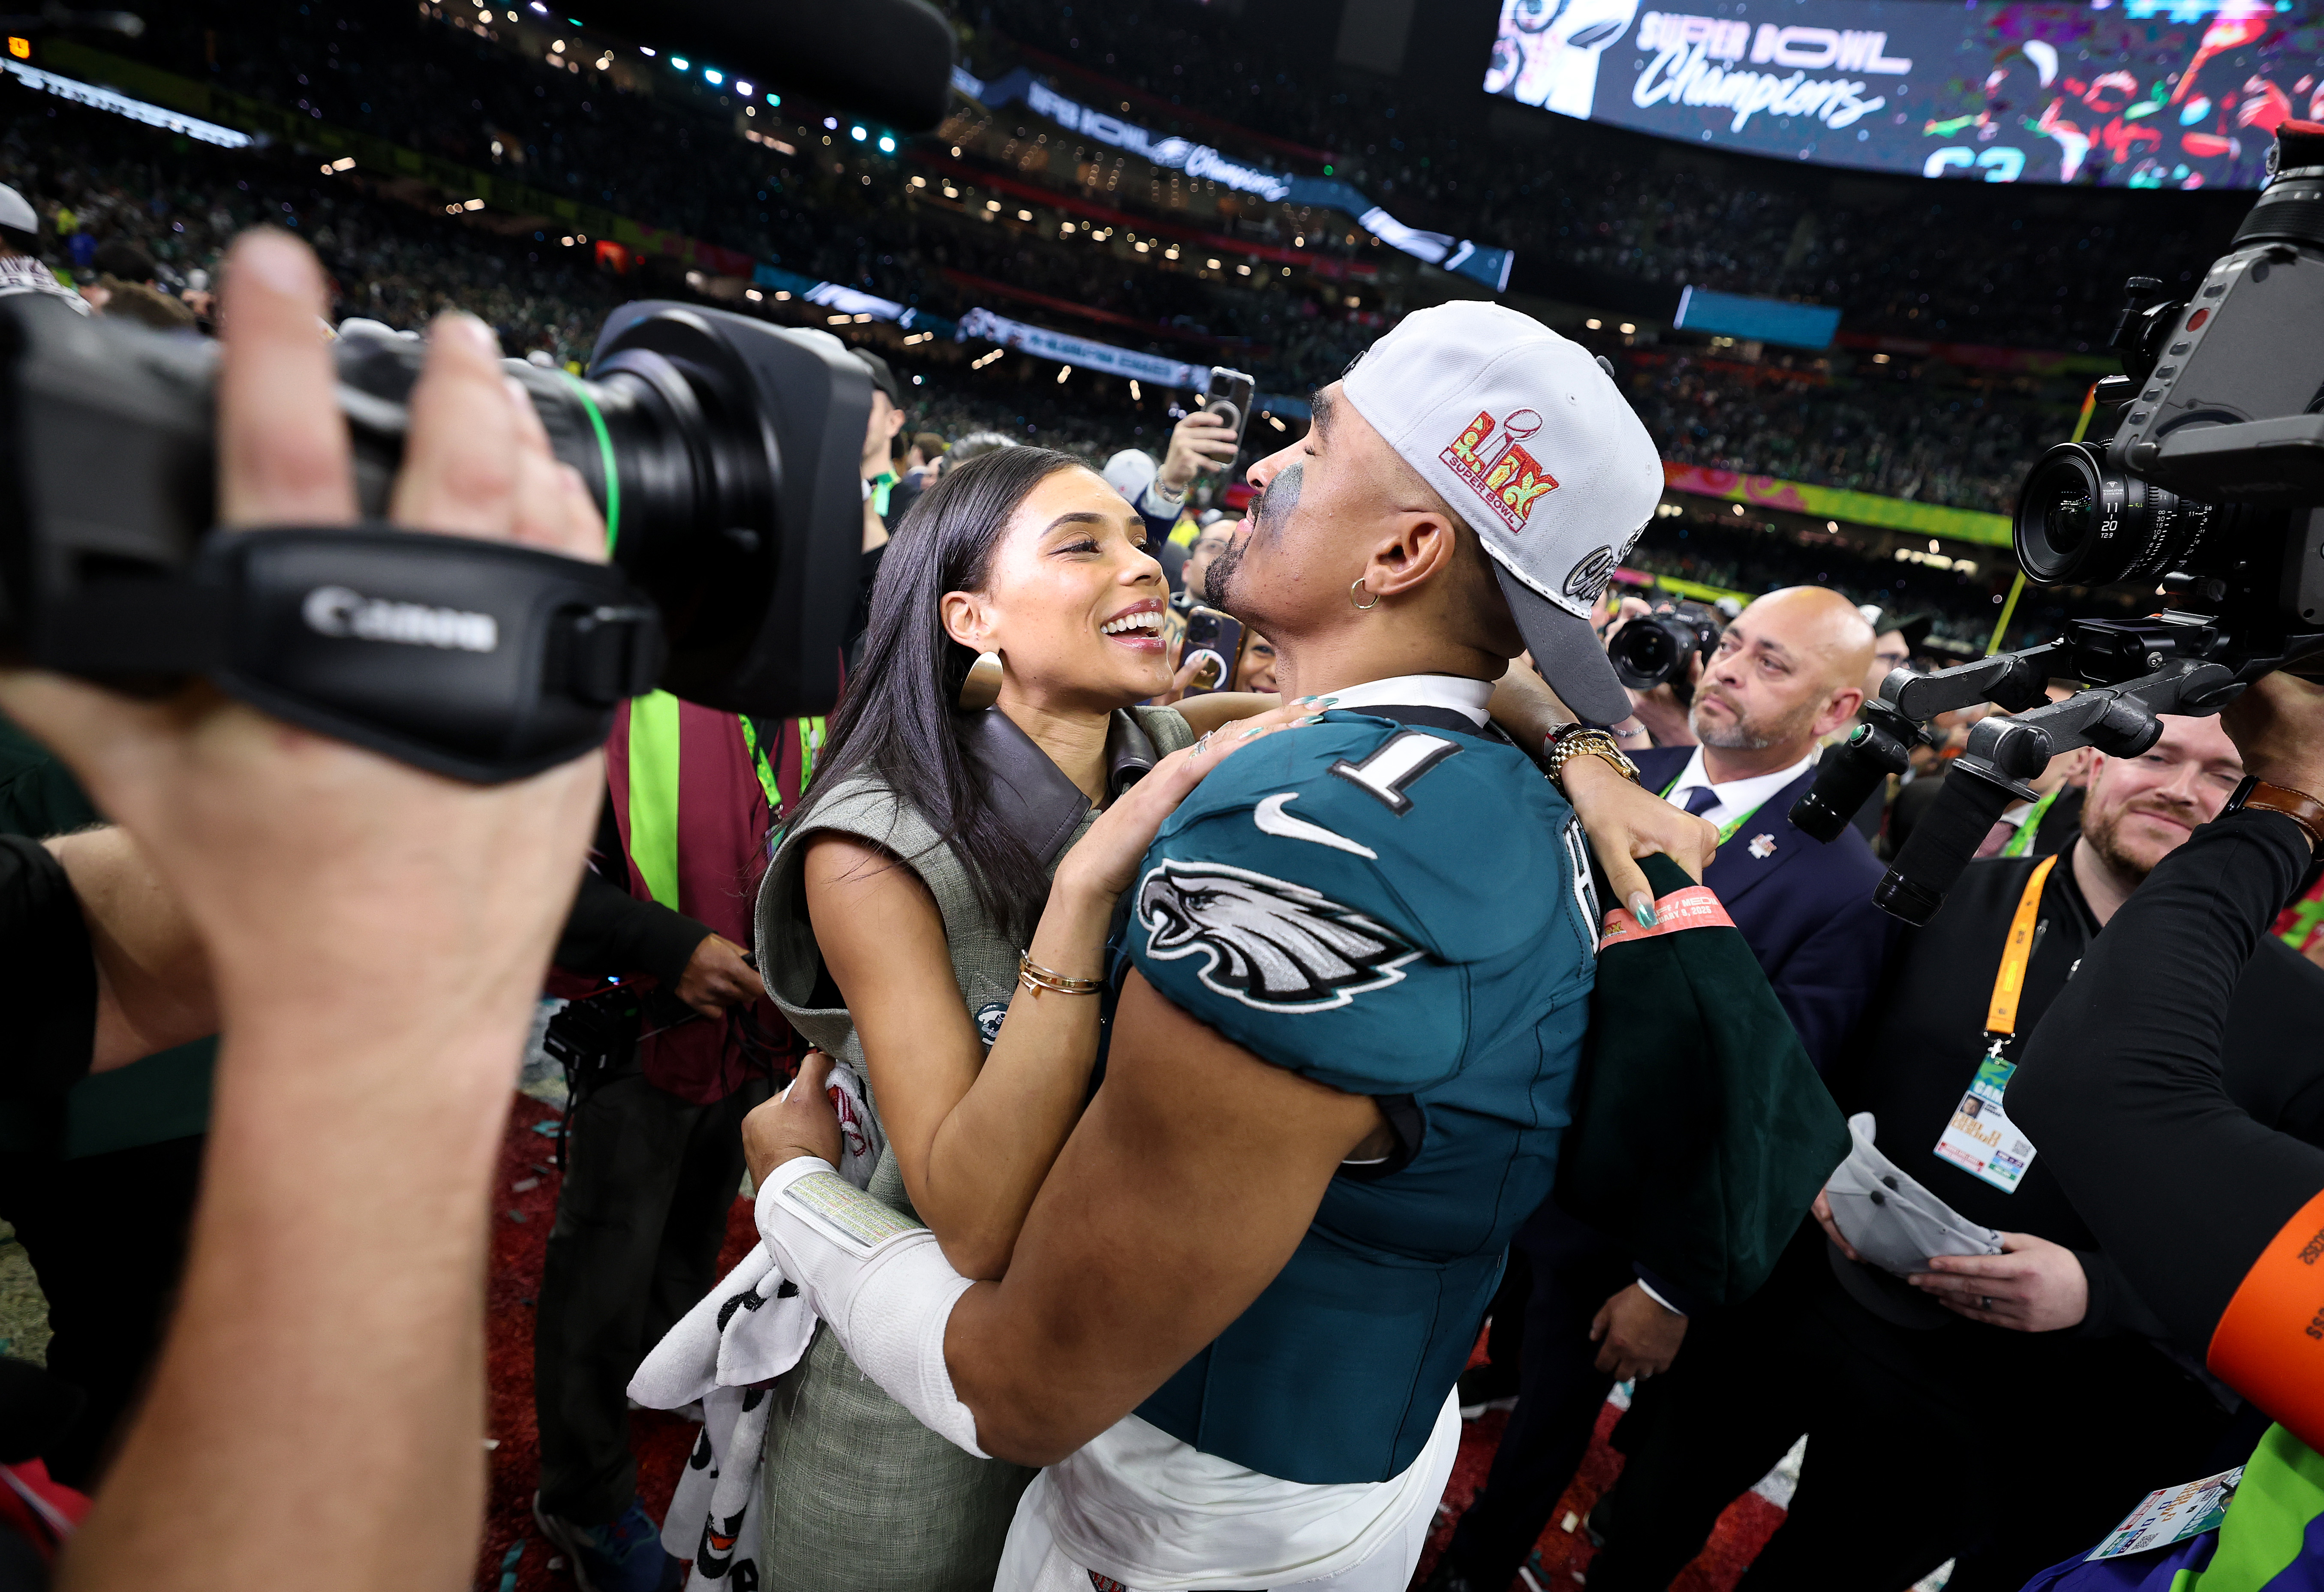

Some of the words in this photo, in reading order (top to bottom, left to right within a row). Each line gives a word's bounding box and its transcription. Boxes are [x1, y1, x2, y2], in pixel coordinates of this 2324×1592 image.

[1636, 11, 1750, 62] SUPER
[1749, 23, 1913, 75] BOWL
[1632, 43, 1886, 133] Champions
[1449, 457, 1485, 493] SUPER
[1486, 492, 1514, 524] BOWL
[2107, 502, 2118, 513] 11
[2101, 521, 2118, 531] 20
[302, 586, 498, 653] Canon
[1326, 729, 1464, 817] 1
[1681, 908, 1691, 917] 9,
[1691, 905, 1712, 915] 2025
[1682, 896, 1719, 907] MEDIA
